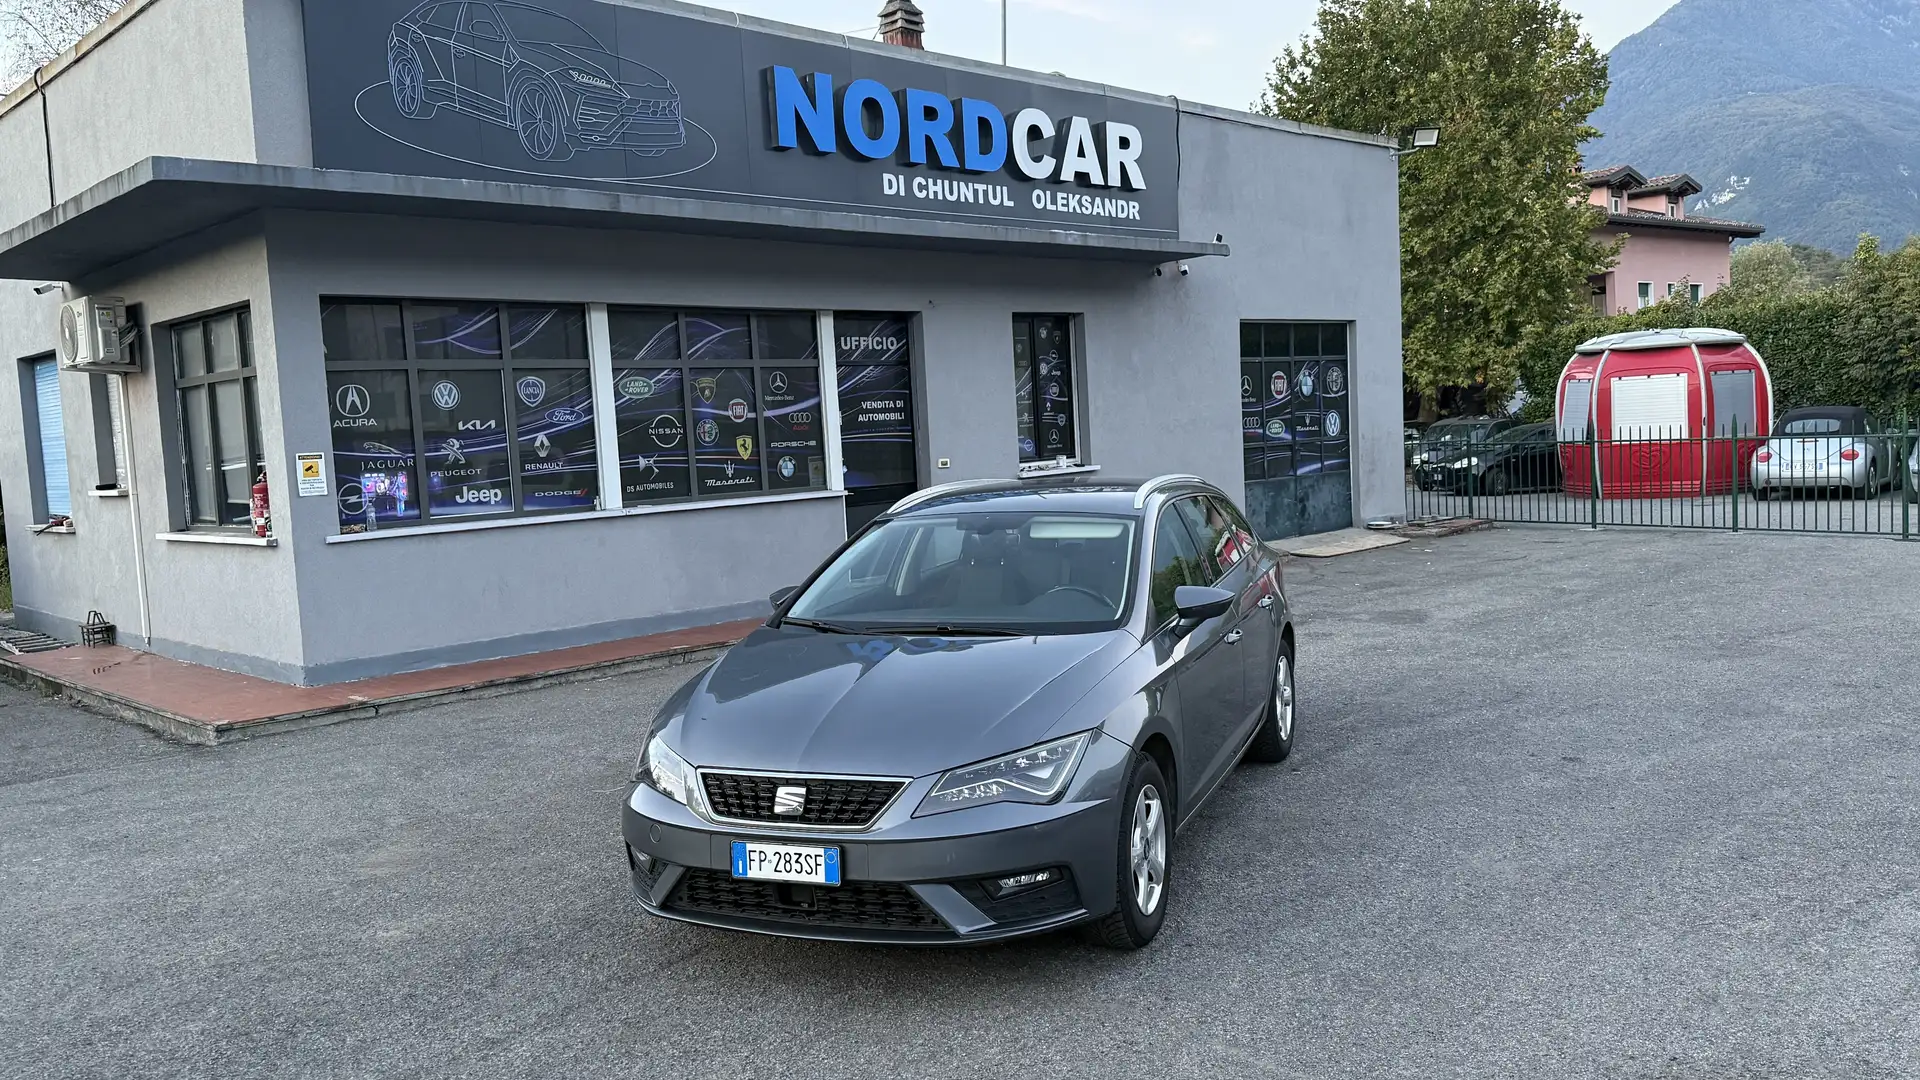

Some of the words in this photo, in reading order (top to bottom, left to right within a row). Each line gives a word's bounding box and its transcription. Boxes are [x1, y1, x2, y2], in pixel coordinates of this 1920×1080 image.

[772, 64, 1147, 190] NORDCAR
[883, 173, 905, 196] DI
[913, 177, 1014, 207] CHUNTUL
[1032, 189, 1140, 220] OLEKSANDR
[840, 336, 898, 350] UFFICIO
[523, 386, 540, 395] LANCIA
[733, 405, 744, 416] FIAT
[861, 401, 894, 410] VENDITA
[895, 400, 904, 408] DI
[552, 410, 577, 422] Ford
[858, 412, 905, 422] AUTOMOBILI
[333, 418, 378, 428] ACURA
[648, 427, 684, 436] NISSAN
[361, 458, 415, 471] JAGUAR
[525, 462, 564, 471] RENAULT
[430, 468, 482, 478] PEUGEOT
[704, 475, 755, 487] Maserati
[626, 485, 635, 493] DS
[636, 481, 674, 491] AUTOMOBILES
[455, 485, 502, 505] Jeep
[535, 489, 581, 497] DODGE
